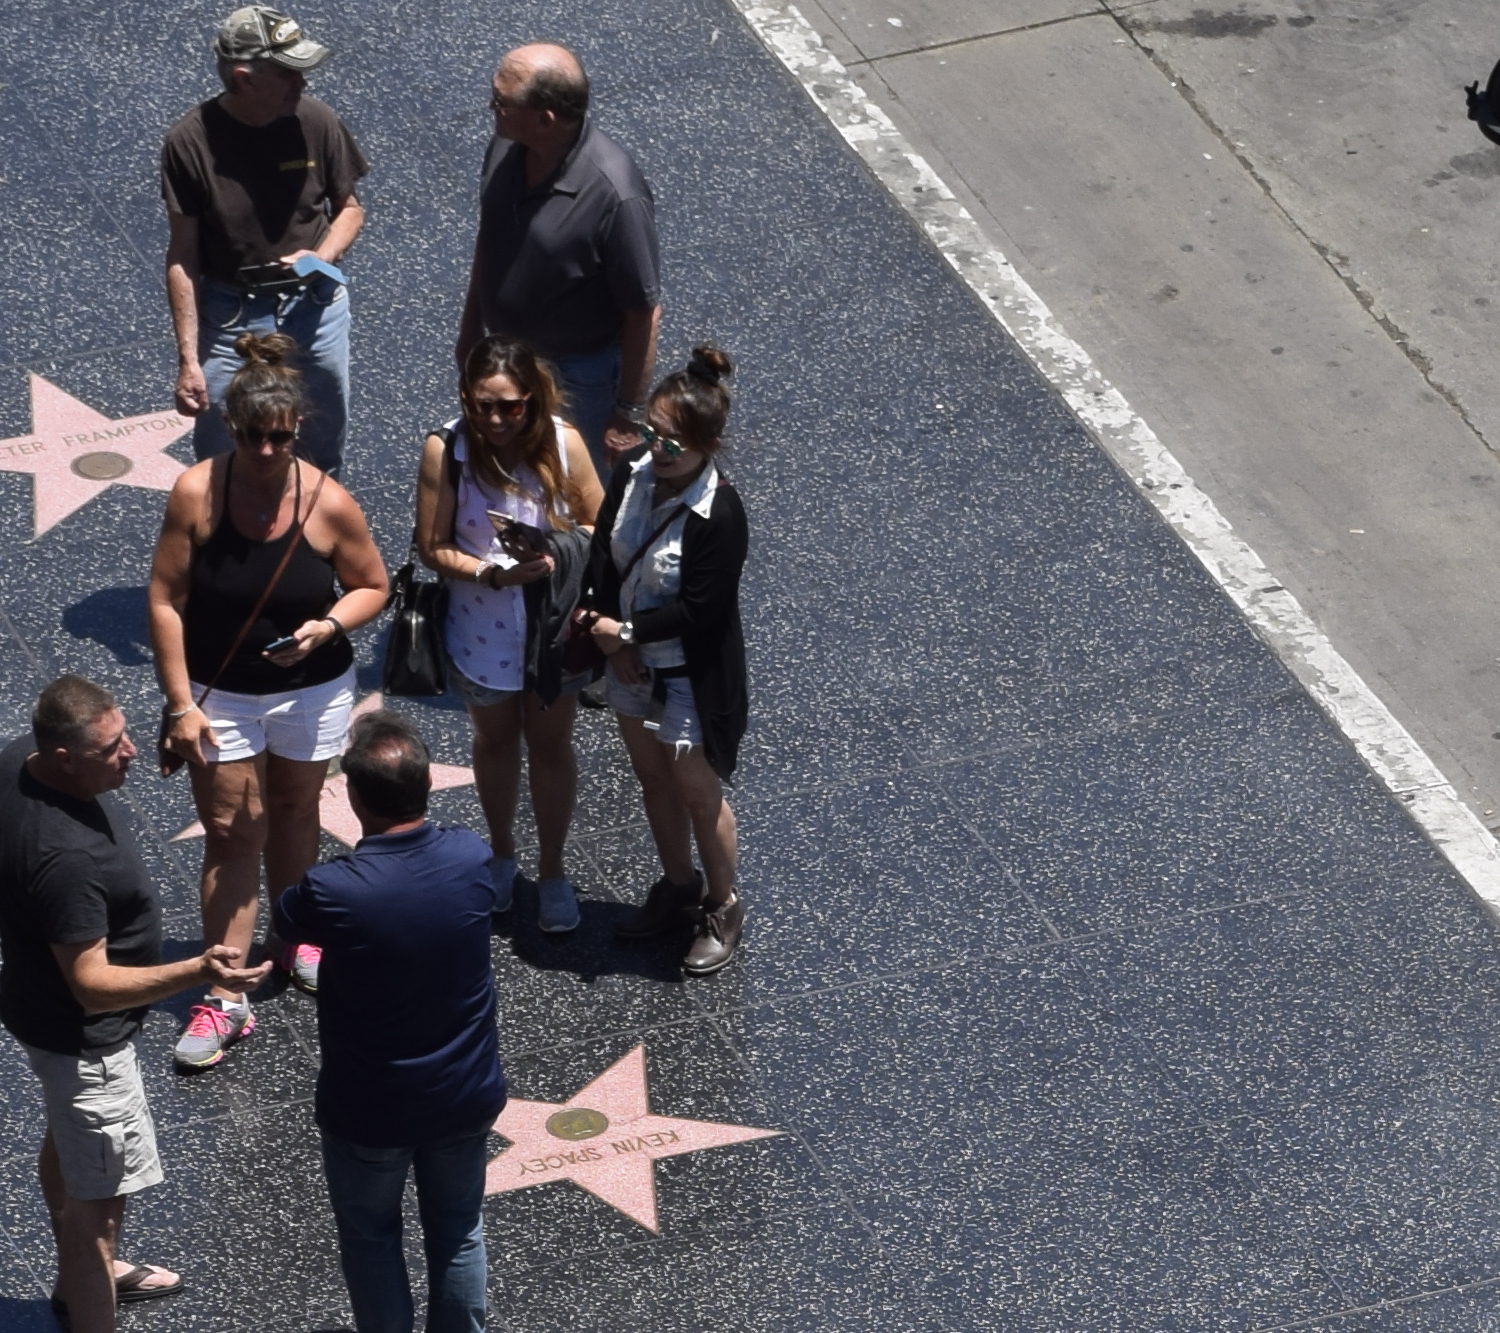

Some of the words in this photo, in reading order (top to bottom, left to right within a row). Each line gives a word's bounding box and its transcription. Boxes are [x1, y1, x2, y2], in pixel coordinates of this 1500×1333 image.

[62, 416, 184, 447] FRAMPTON
[612, 1129, 681, 1154] KEVIN
[518, 1146, 604, 1176] SPACEY
